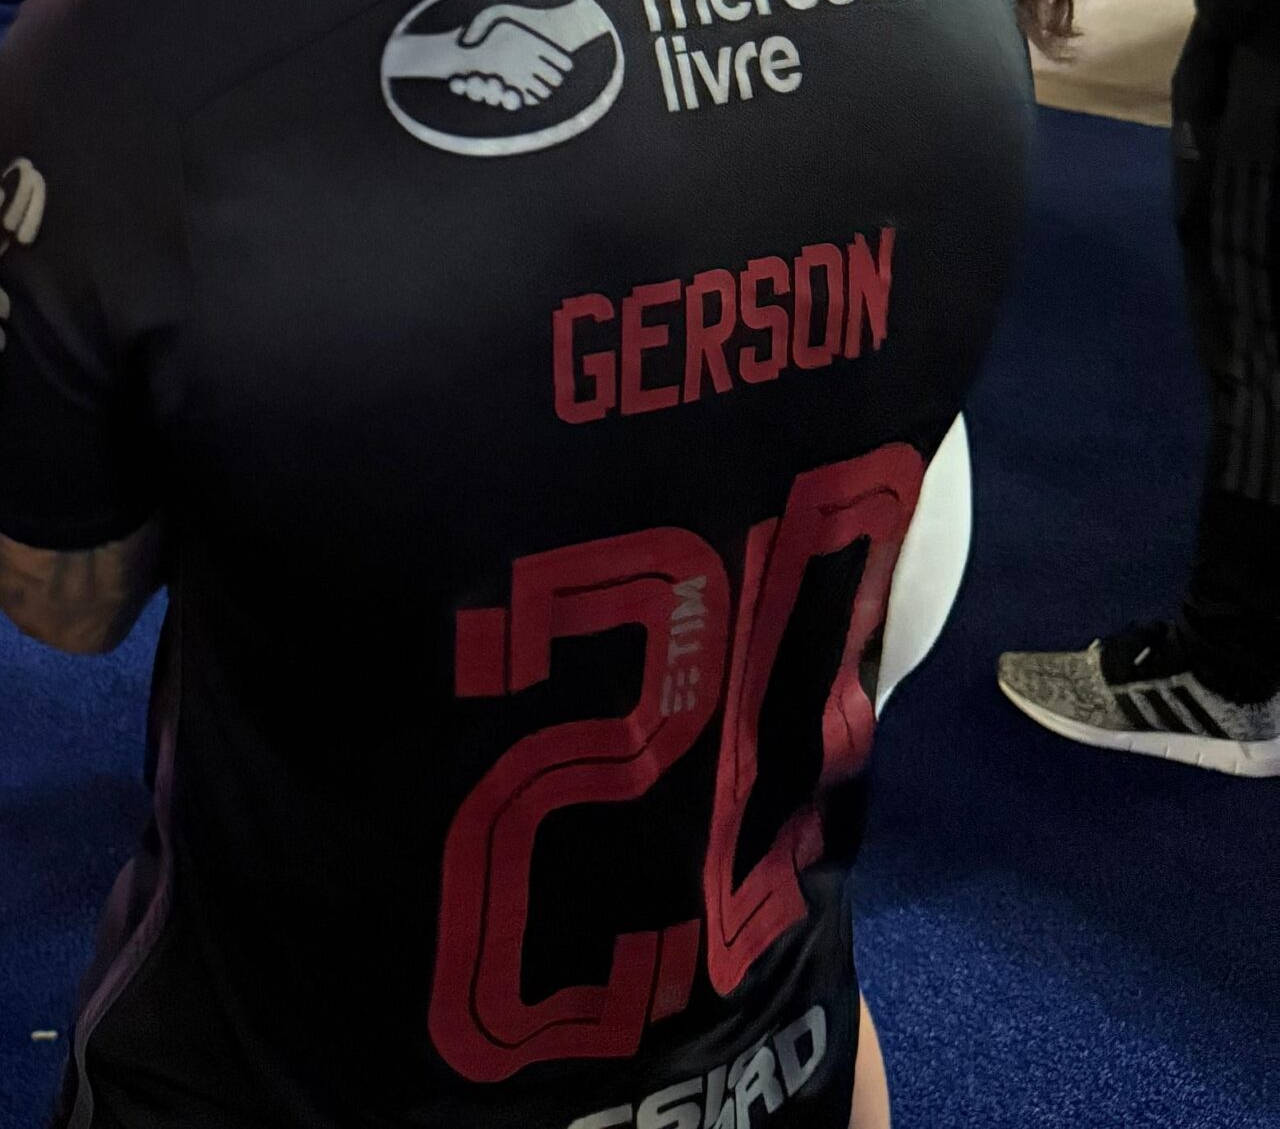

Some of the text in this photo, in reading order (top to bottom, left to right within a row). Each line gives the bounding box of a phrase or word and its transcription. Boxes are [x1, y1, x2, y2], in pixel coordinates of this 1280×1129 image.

[655, 34, 803, 112] livre
[552, 227, 896, 424] GERSON
[428, 442, 925, 1082] 20
